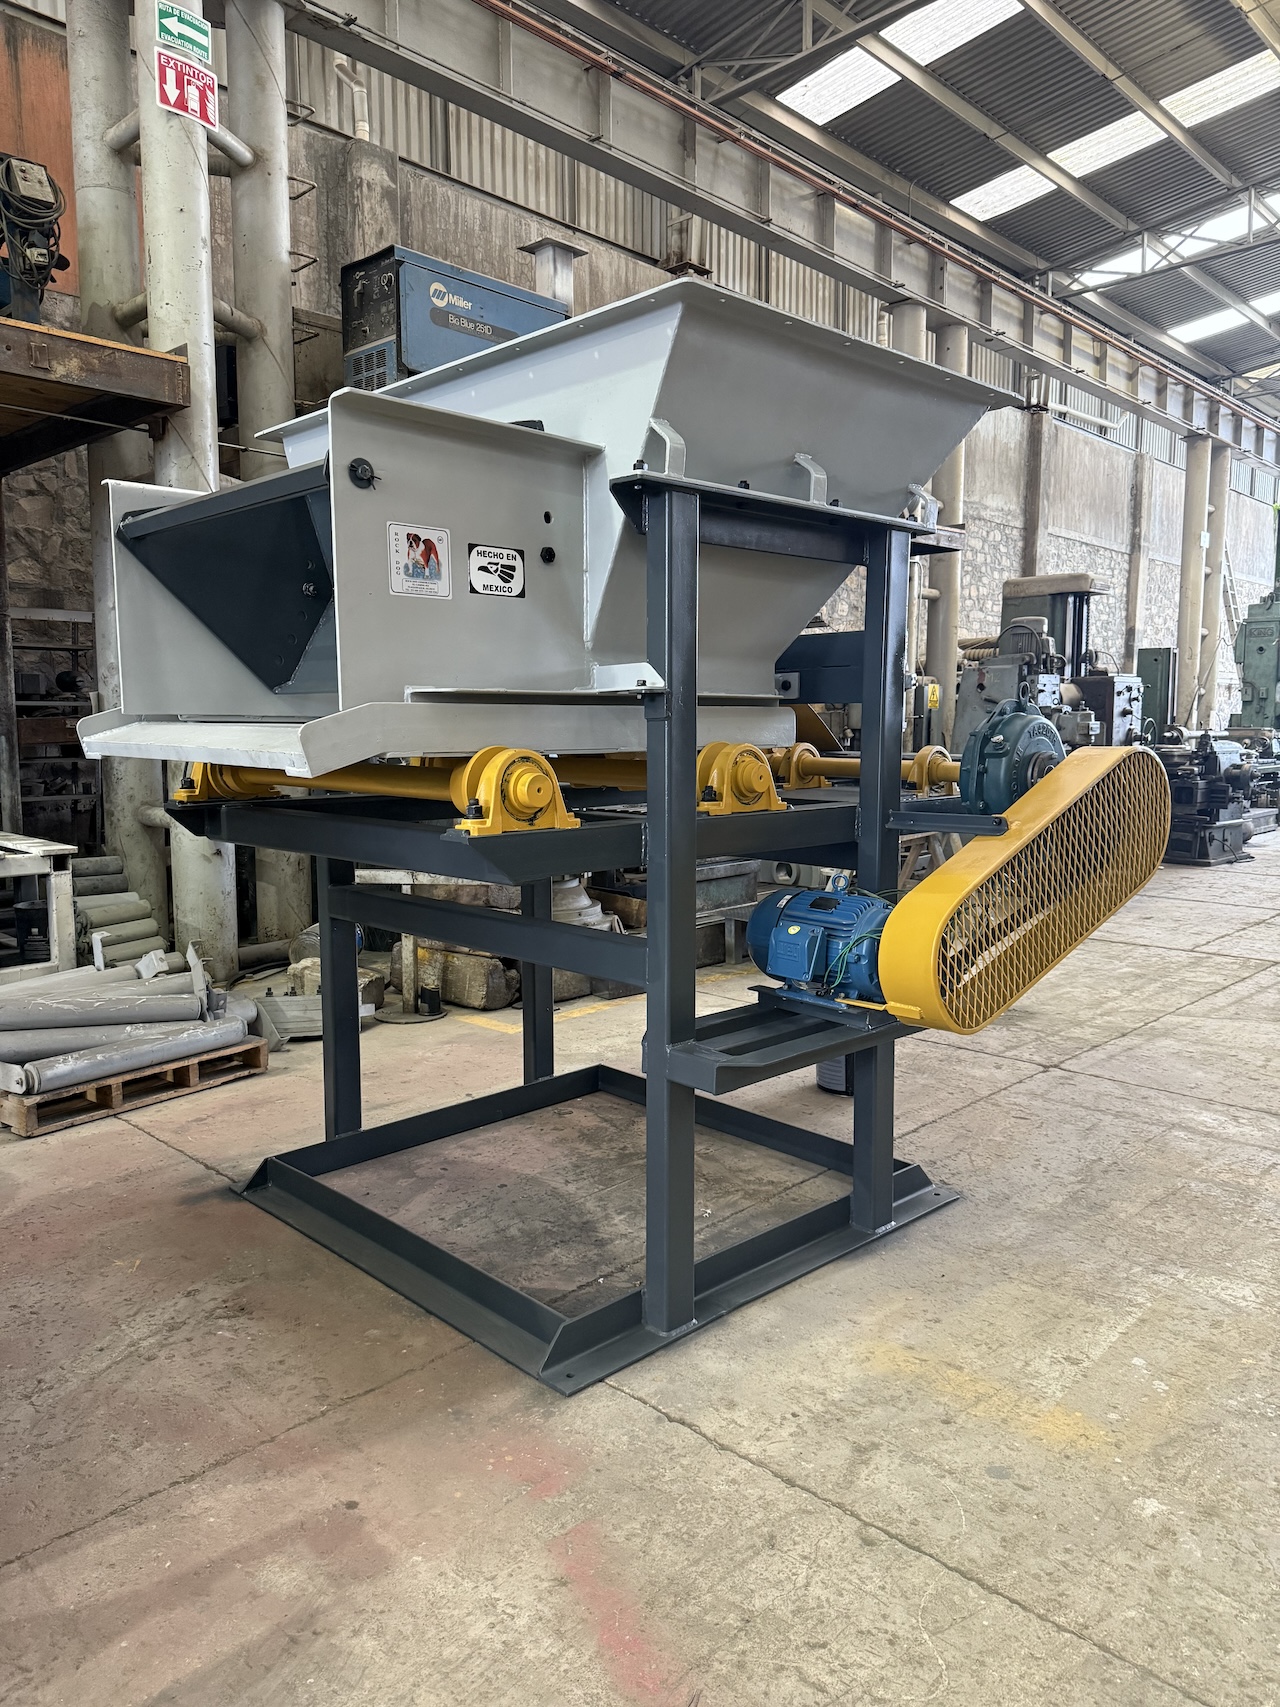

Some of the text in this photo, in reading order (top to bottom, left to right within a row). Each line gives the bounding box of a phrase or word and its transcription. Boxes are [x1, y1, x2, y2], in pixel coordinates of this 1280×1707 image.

[159, 3, 173, 14] RUTA
[173, 8, 181, 16] DE
[161, 33, 208, 59] EVACUATION ROUTE
[161, 56, 213, 87] EXTINTOR
[449, 293, 472, 310] Miller
[460, 317, 475, 330] Blue
[476, 323, 492, 334] 251D
[476, 549, 517, 561] HECHO EN
[482, 584, 513, 594] MEXICO
[1250, 628, 1274, 637] KING
